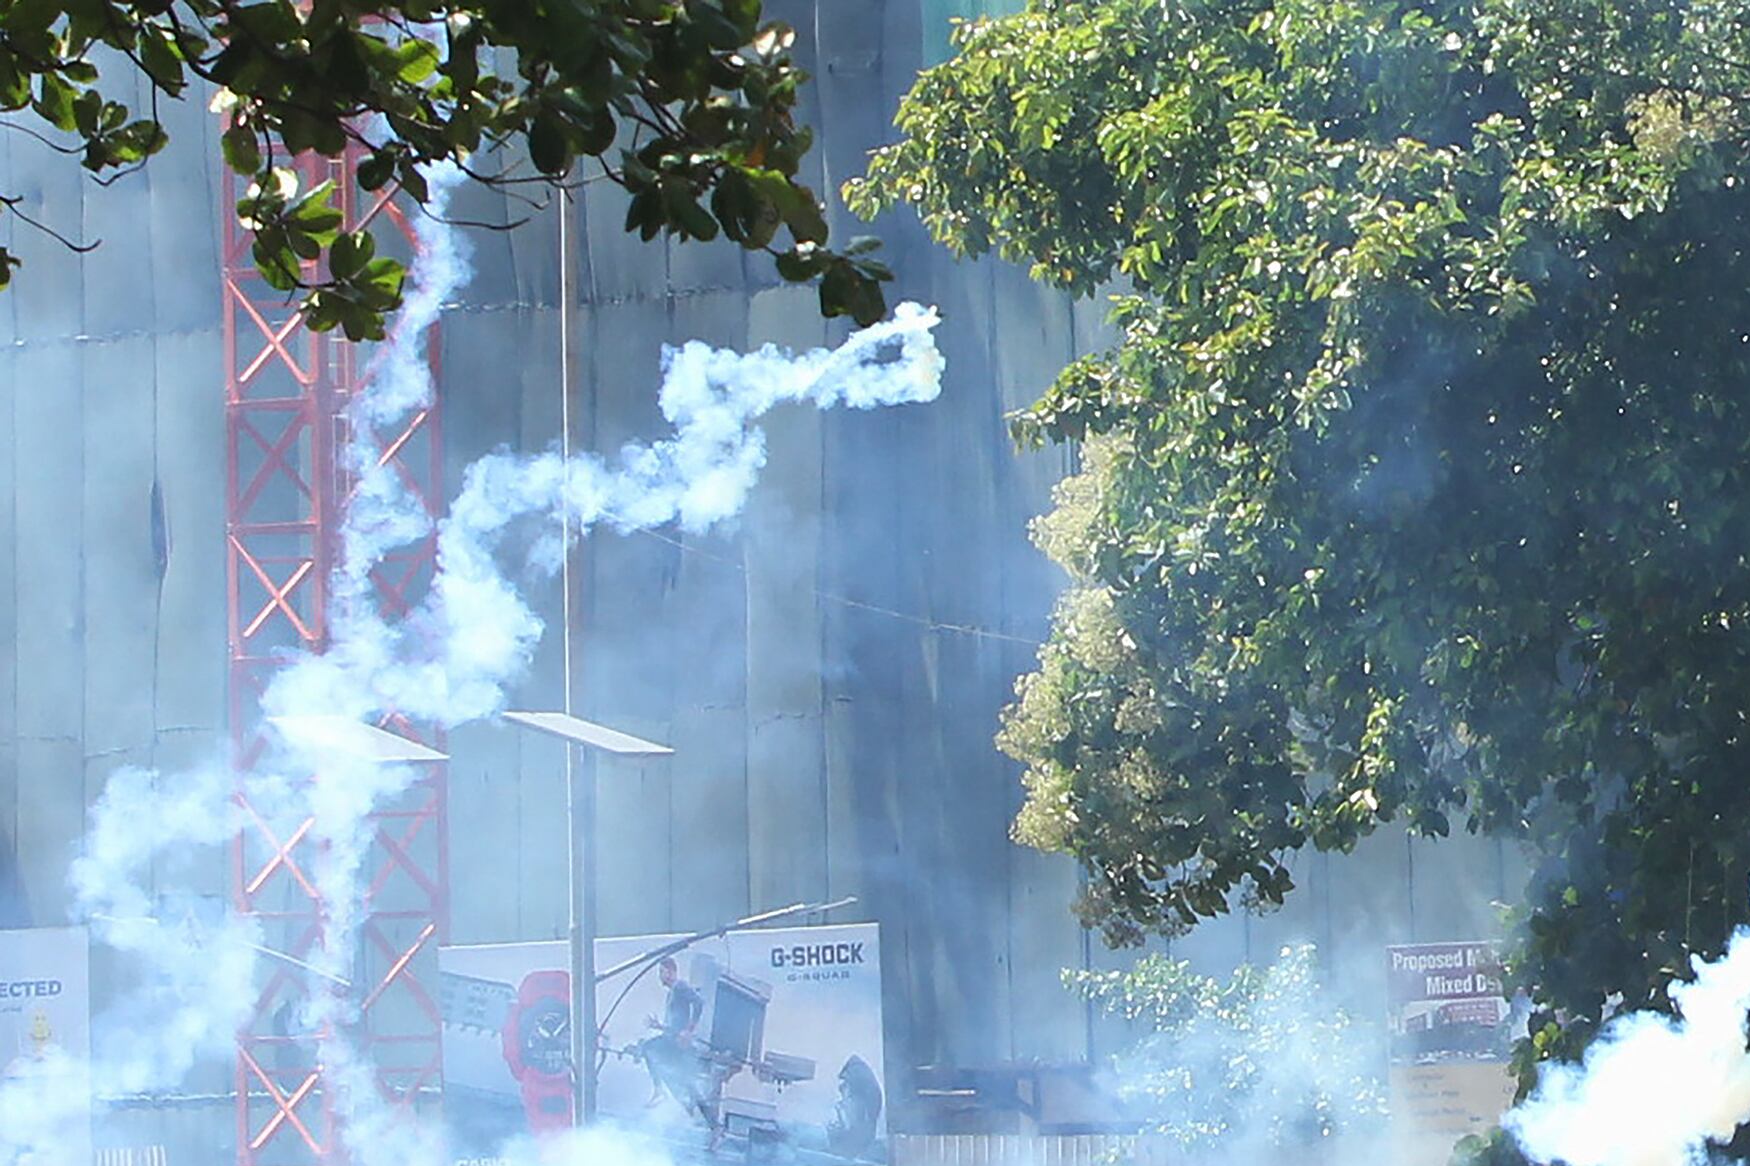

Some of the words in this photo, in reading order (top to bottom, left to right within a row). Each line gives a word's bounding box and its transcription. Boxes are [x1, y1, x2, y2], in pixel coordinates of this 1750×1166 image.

[771, 943, 864, 968] G-SHOCK
[1393, 949, 1463, 973] Proposed
[1426, 975, 1472, 995] Mixed
